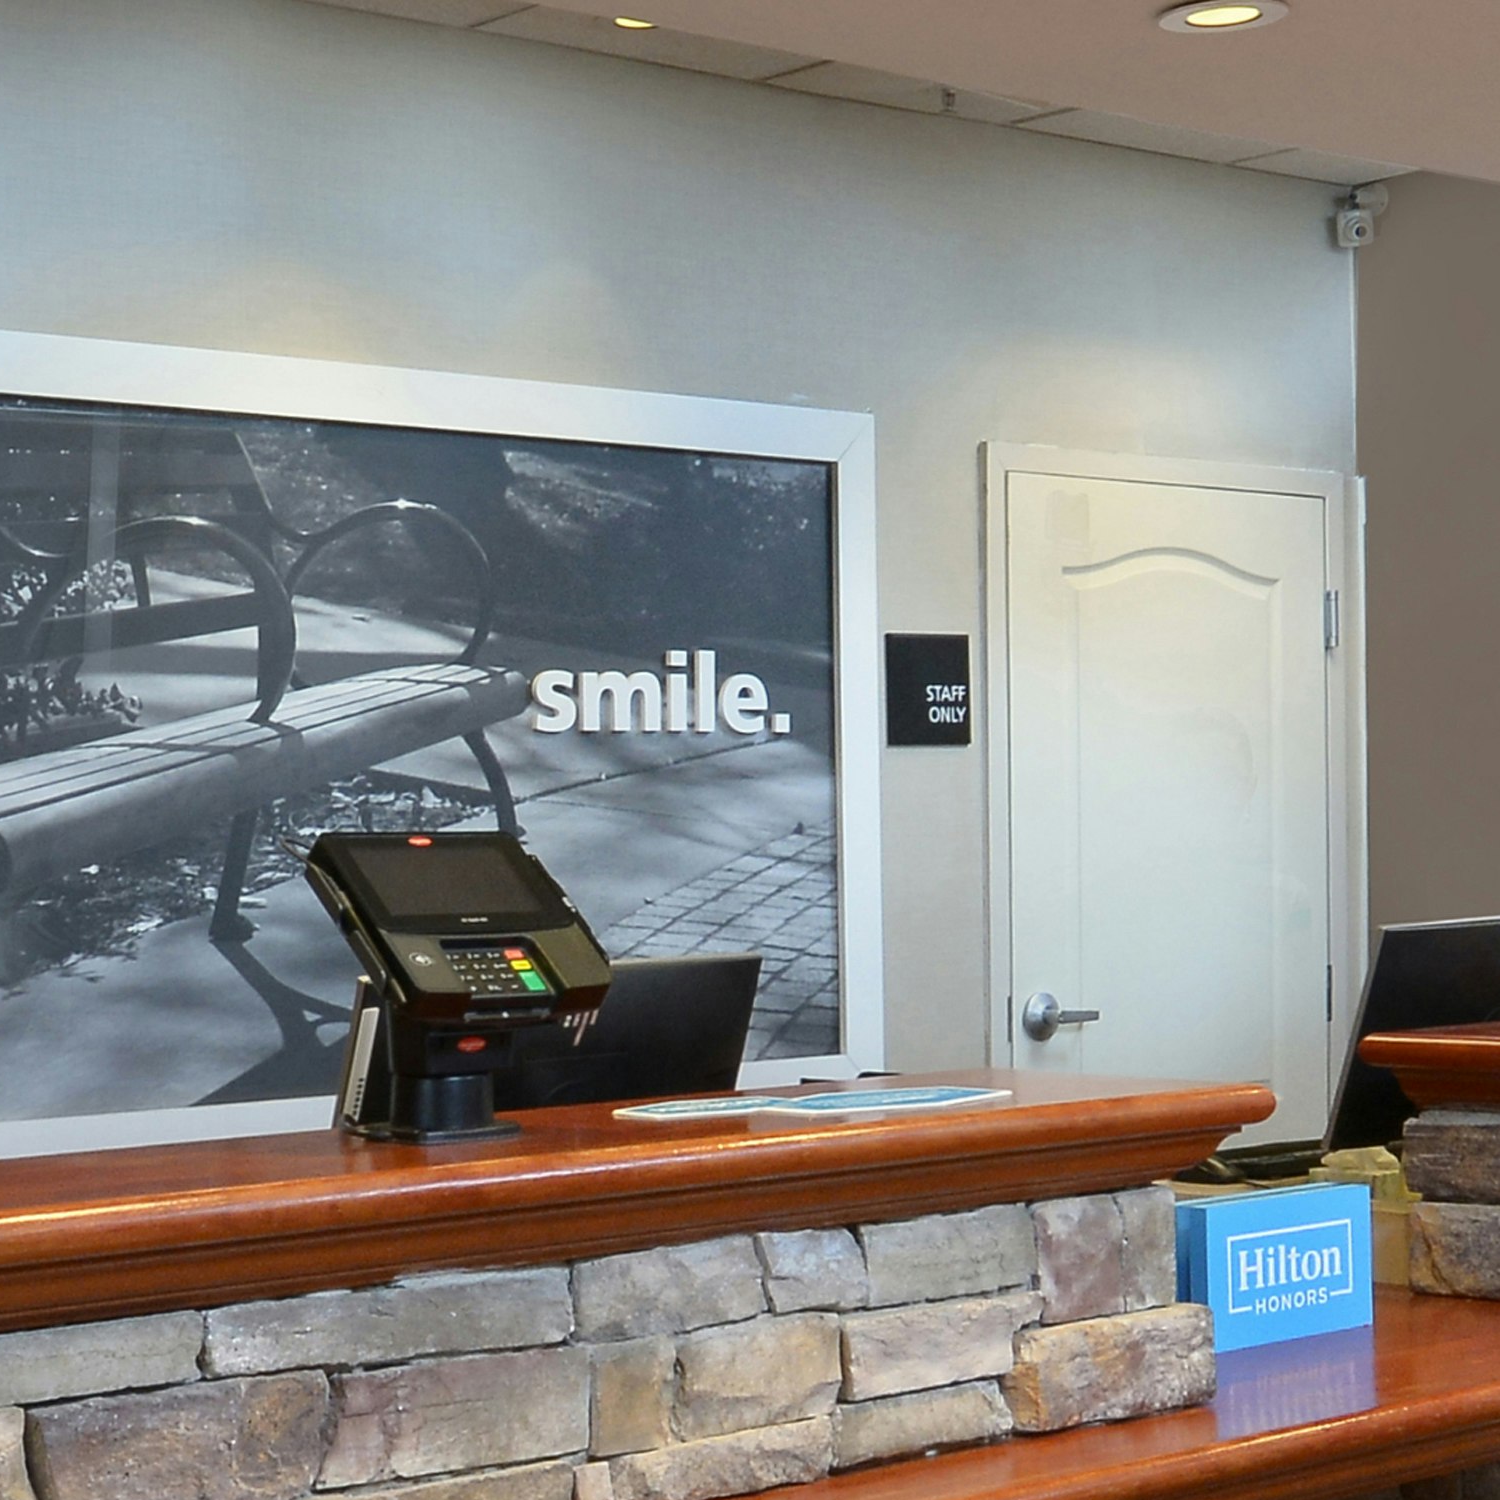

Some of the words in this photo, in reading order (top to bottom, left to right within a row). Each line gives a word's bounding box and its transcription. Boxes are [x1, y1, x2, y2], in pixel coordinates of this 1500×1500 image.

[530, 649, 791, 734] smile.
[926, 685, 967, 702] STAFF
[929, 706, 967, 723] ONLY
[1238, 1243, 1342, 1292] Hilton
[1255, 1286, 1329, 1316] HONORS
